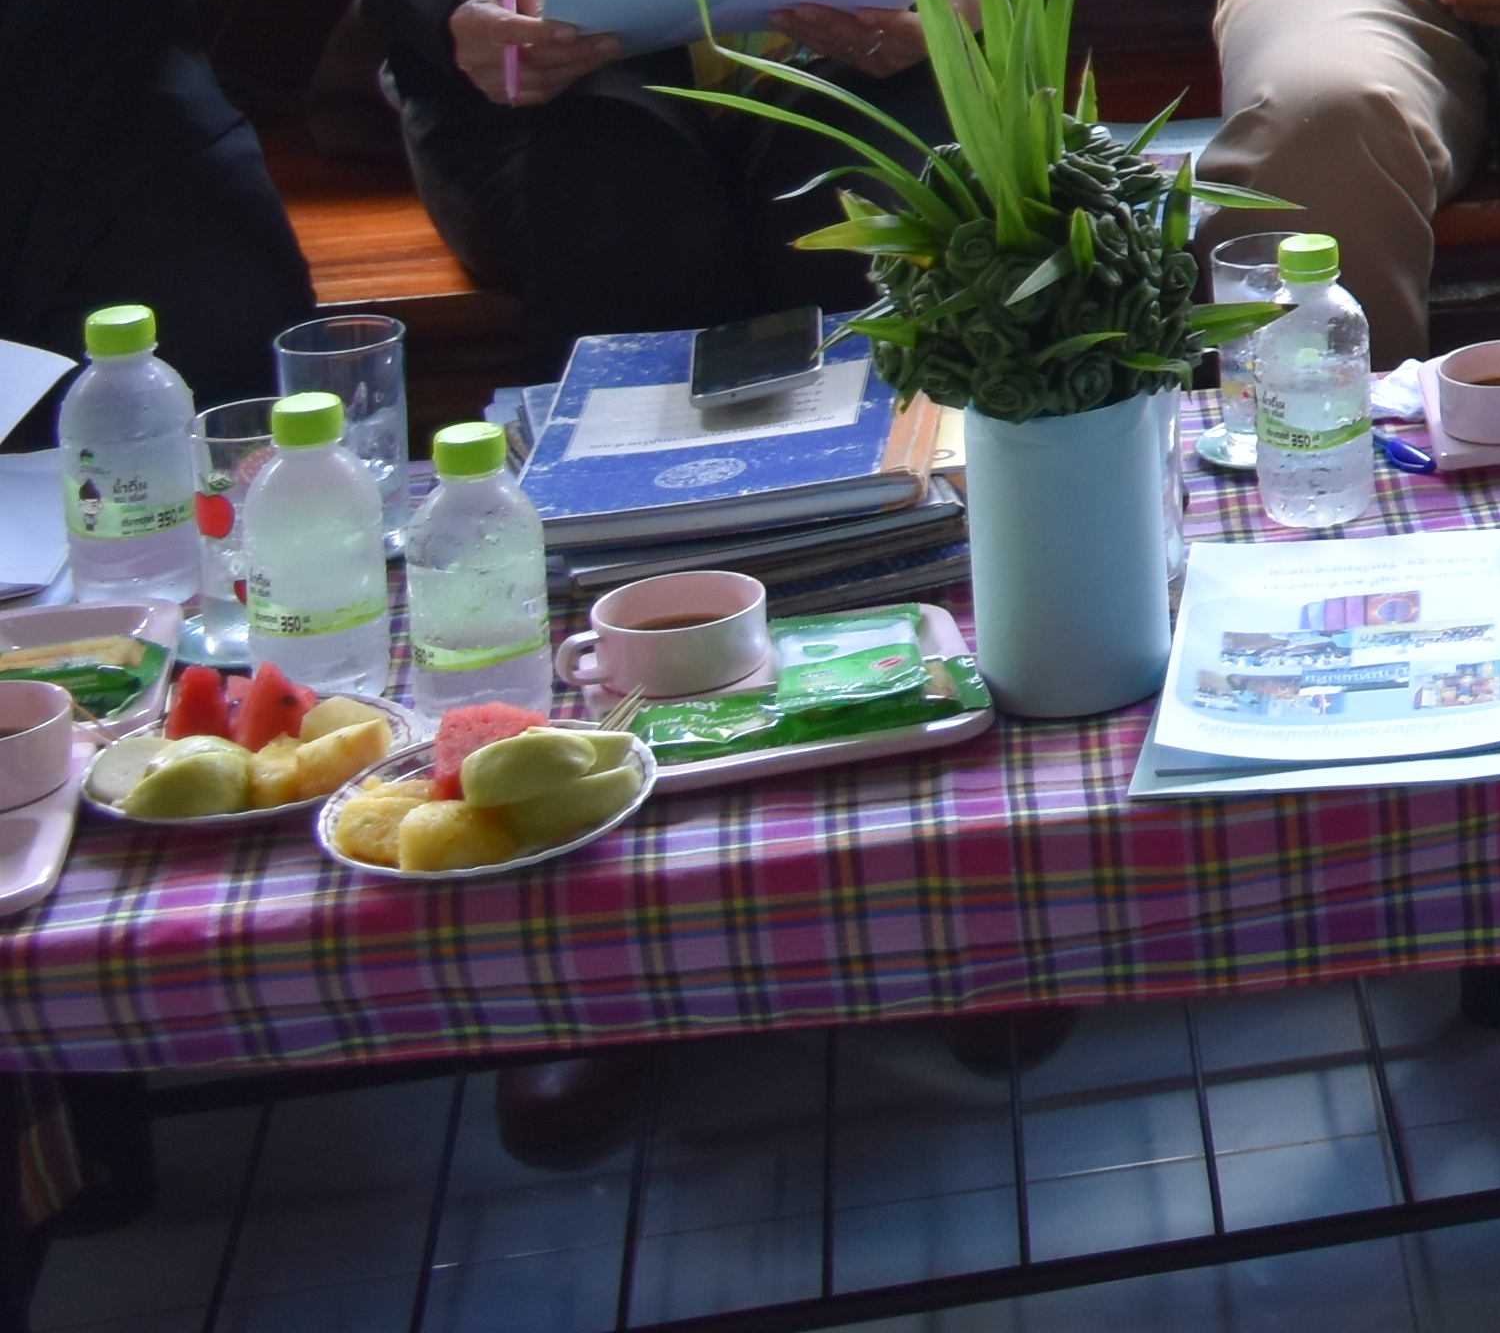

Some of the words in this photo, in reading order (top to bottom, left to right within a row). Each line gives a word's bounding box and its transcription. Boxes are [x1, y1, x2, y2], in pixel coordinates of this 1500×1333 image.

[1291, 434, 1311, 449] 350
[113, 475, 147, 495] น้ำดื่ม
[157, 508, 178, 529] 350
[281, 615, 301, 633] 350
